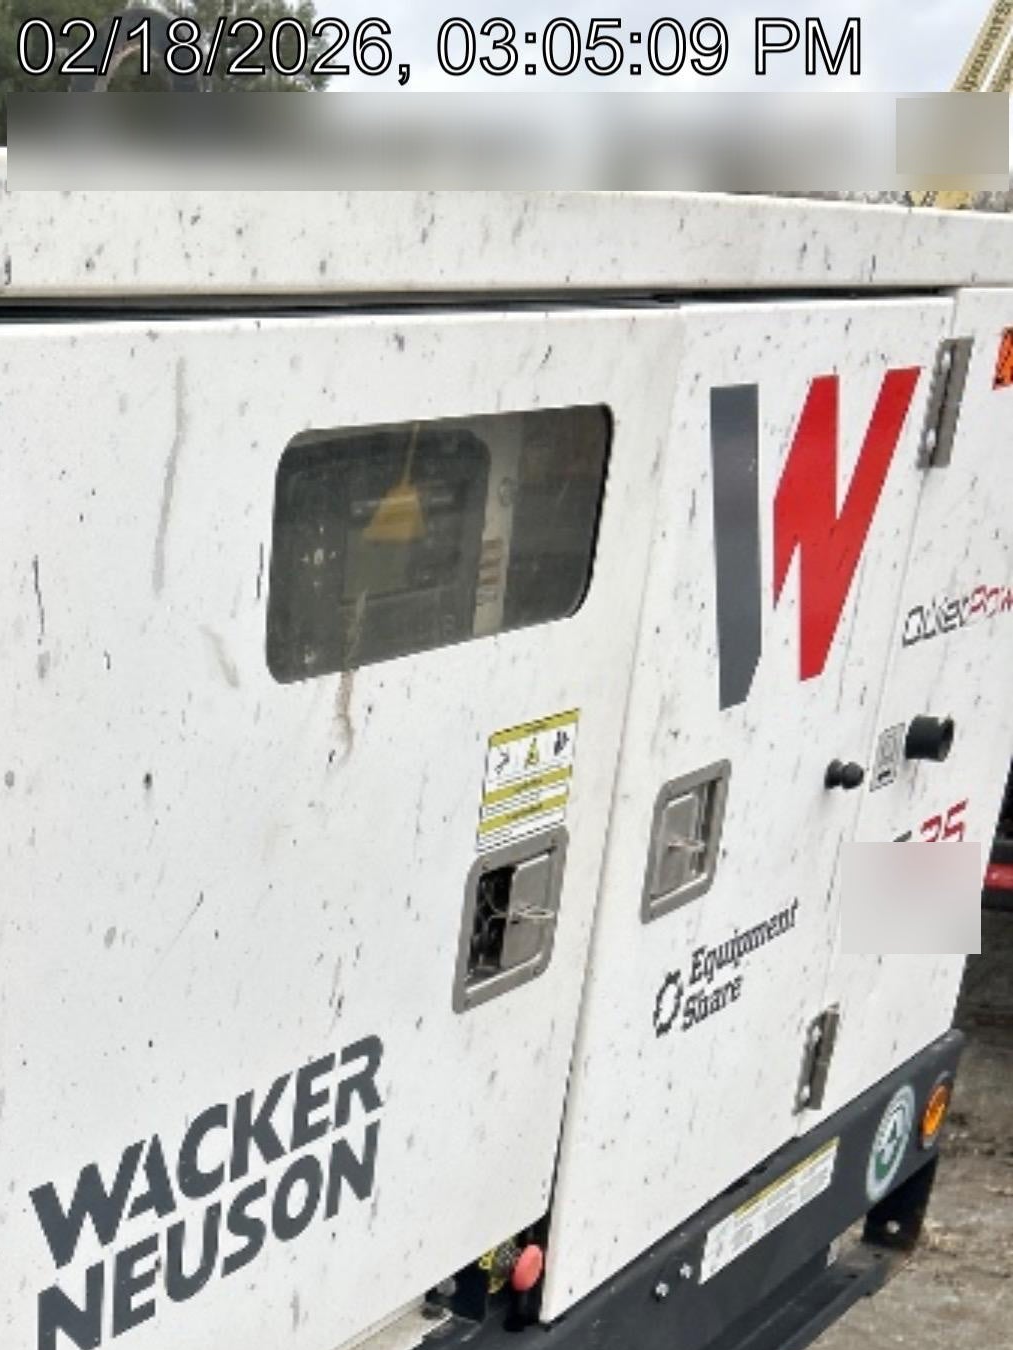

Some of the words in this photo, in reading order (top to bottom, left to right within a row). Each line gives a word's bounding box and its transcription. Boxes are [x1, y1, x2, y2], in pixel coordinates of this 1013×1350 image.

[689, 896, 798, 984] Equipment
[681, 975, 743, 1031] Share
[29, 1034, 384, 1270] WACKER
